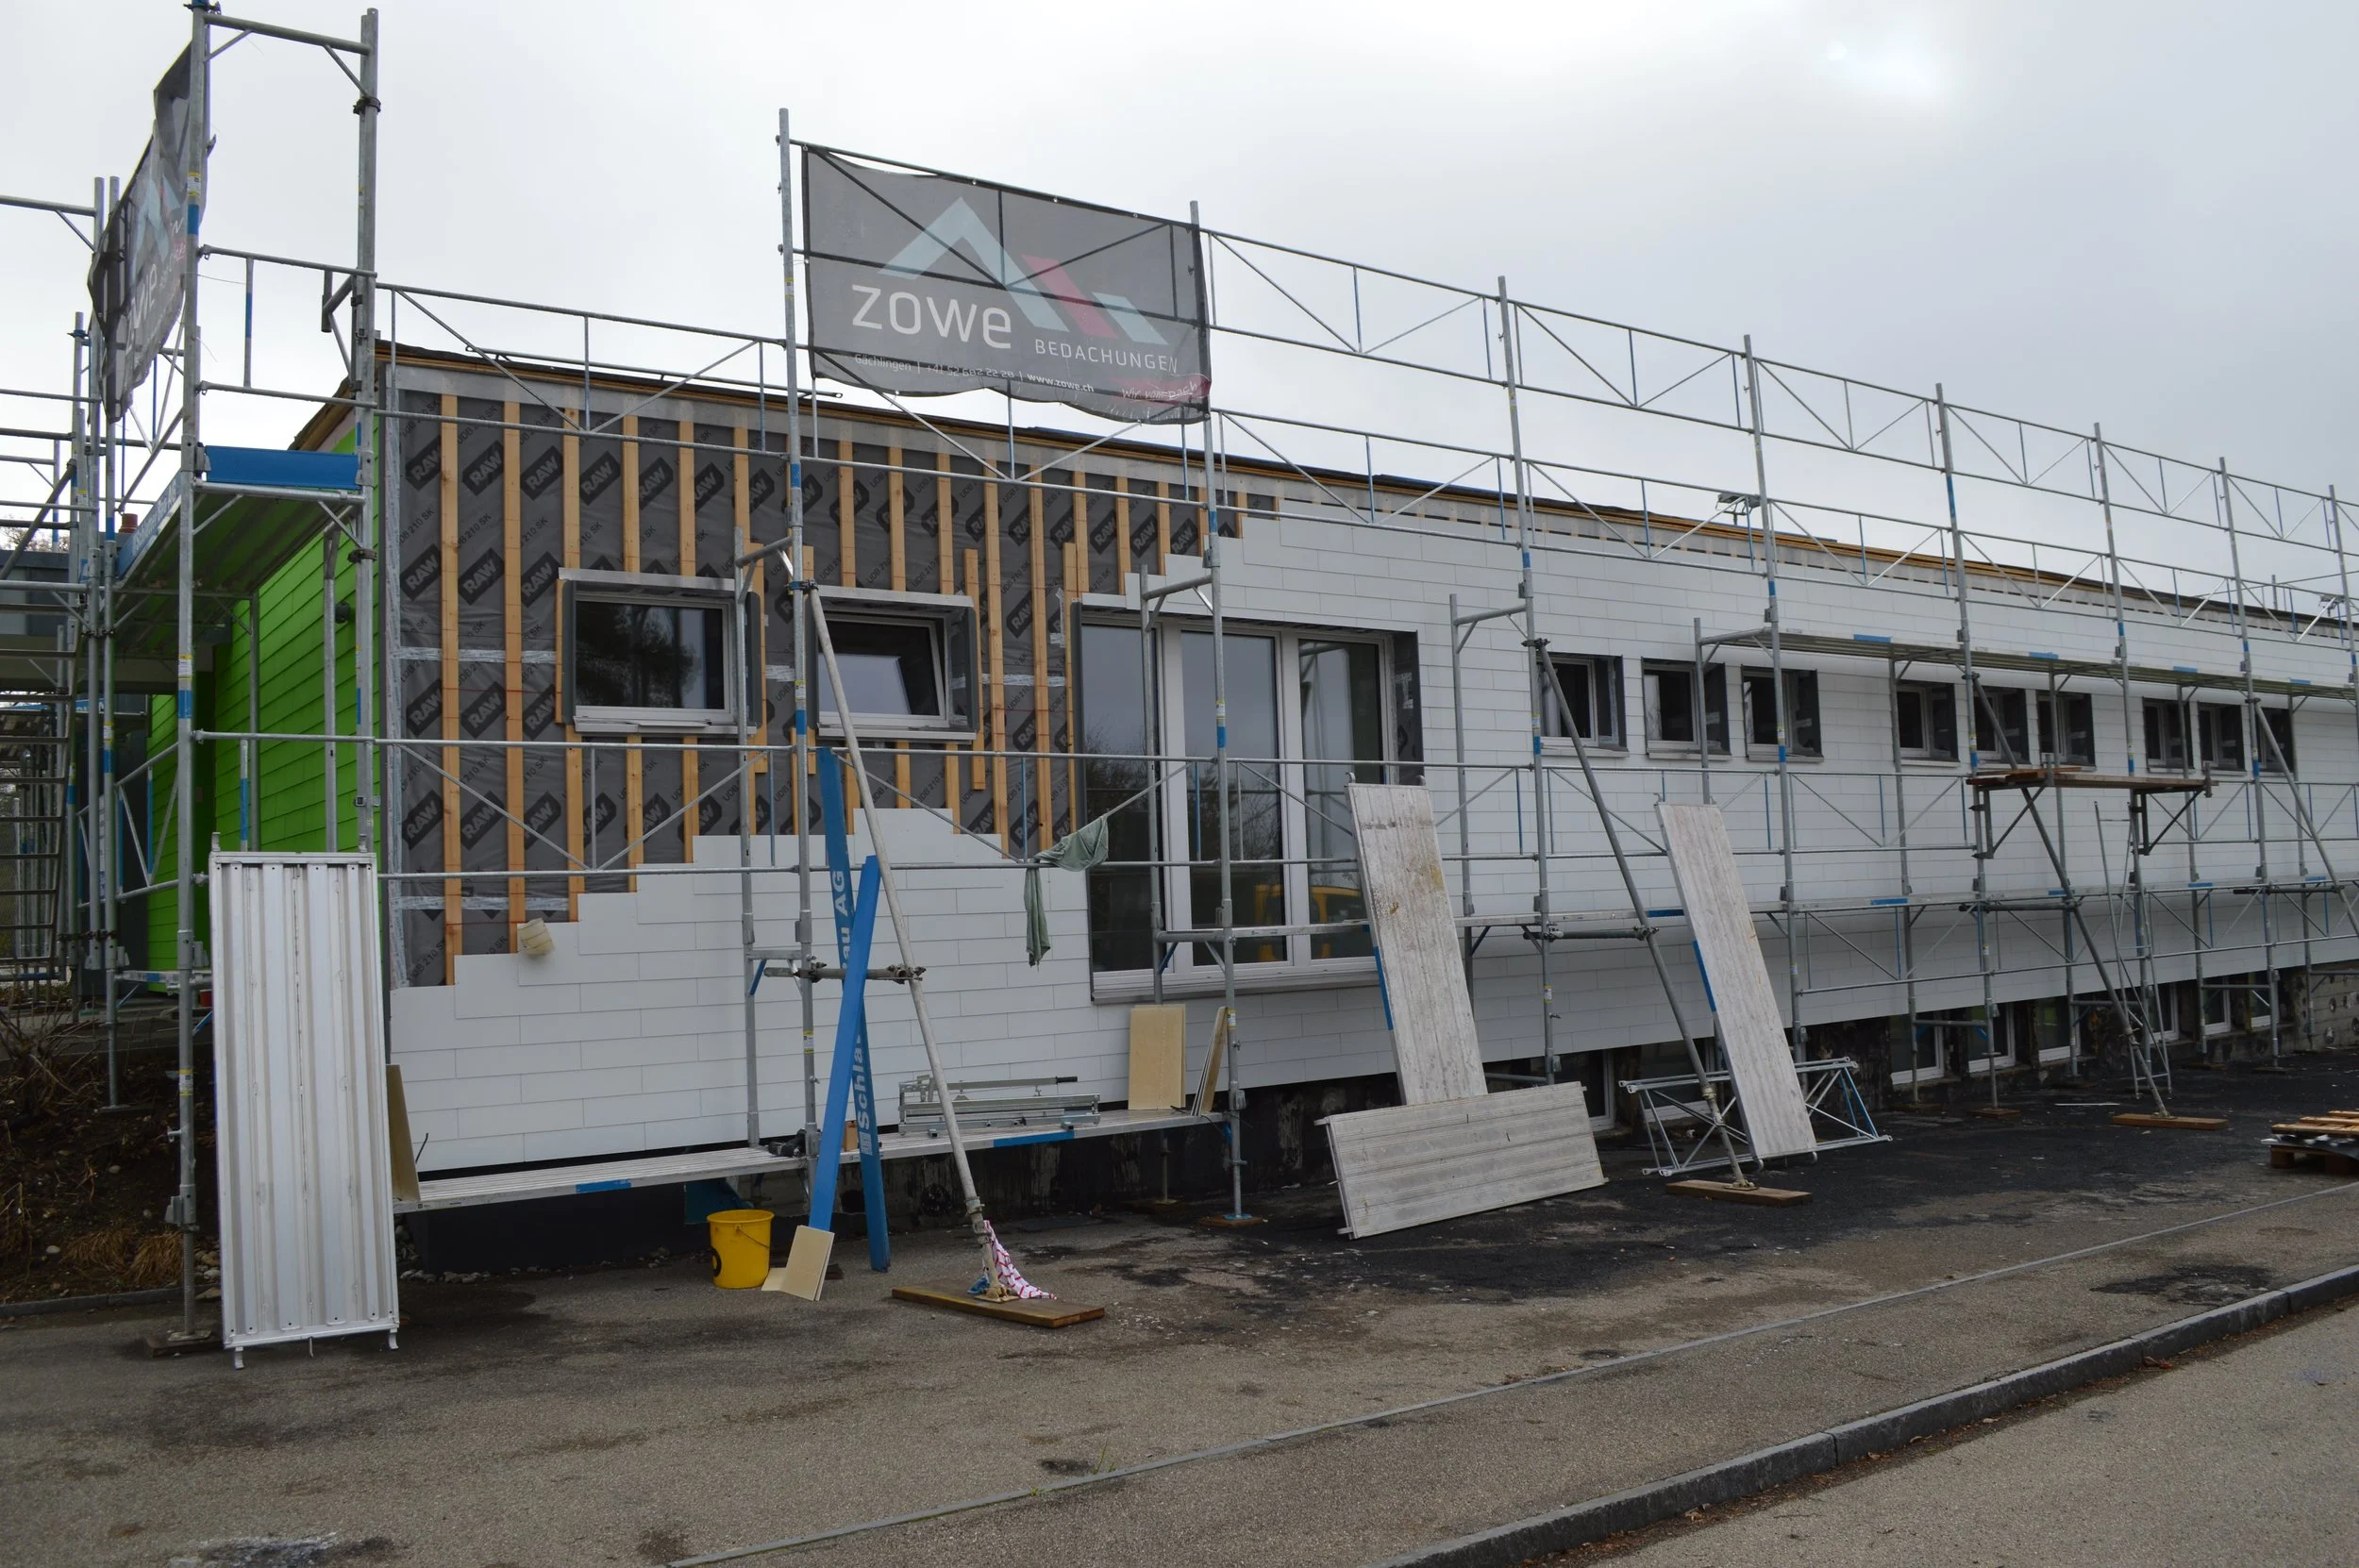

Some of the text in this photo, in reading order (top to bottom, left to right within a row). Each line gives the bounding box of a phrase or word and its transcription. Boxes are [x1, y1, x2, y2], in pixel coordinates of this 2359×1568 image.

[1034, 338, 1178, 375] BEDACHUNGEN
[1027, 372, 1095, 392] www.zowe.ch
[410, 448, 441, 482] RAW
[469, 450, 502, 485] RAW
[525, 455, 559, 491] RAW
[580, 460, 613, 494] RAW
[695, 473, 716, 501] AW
[408, 518, 423, 536] 210
[422, 507, 436, 521] SK
[464, 523, 480, 540] 210
[478, 512, 492, 525] SK
[535, 516, 549, 530] SK
[590, 521, 604, 535] SK
[1012, 517, 1030, 538] RA
[1132, 521, 1156, 549] RAW
[1171, 527, 1193, 553] RAW
[405, 555, 438, 591] RAW
[462, 559, 497, 593] RAW
[522, 561, 553, 597] RAW
[410, 688, 443, 726] RAW
[468, 692, 502, 729] RAW
[407, 801, 438, 839] RAW
[461, 806, 495, 839] RAW
[832, 869, 849, 918] AG
[852, 1034, 870, 1130] Schla
